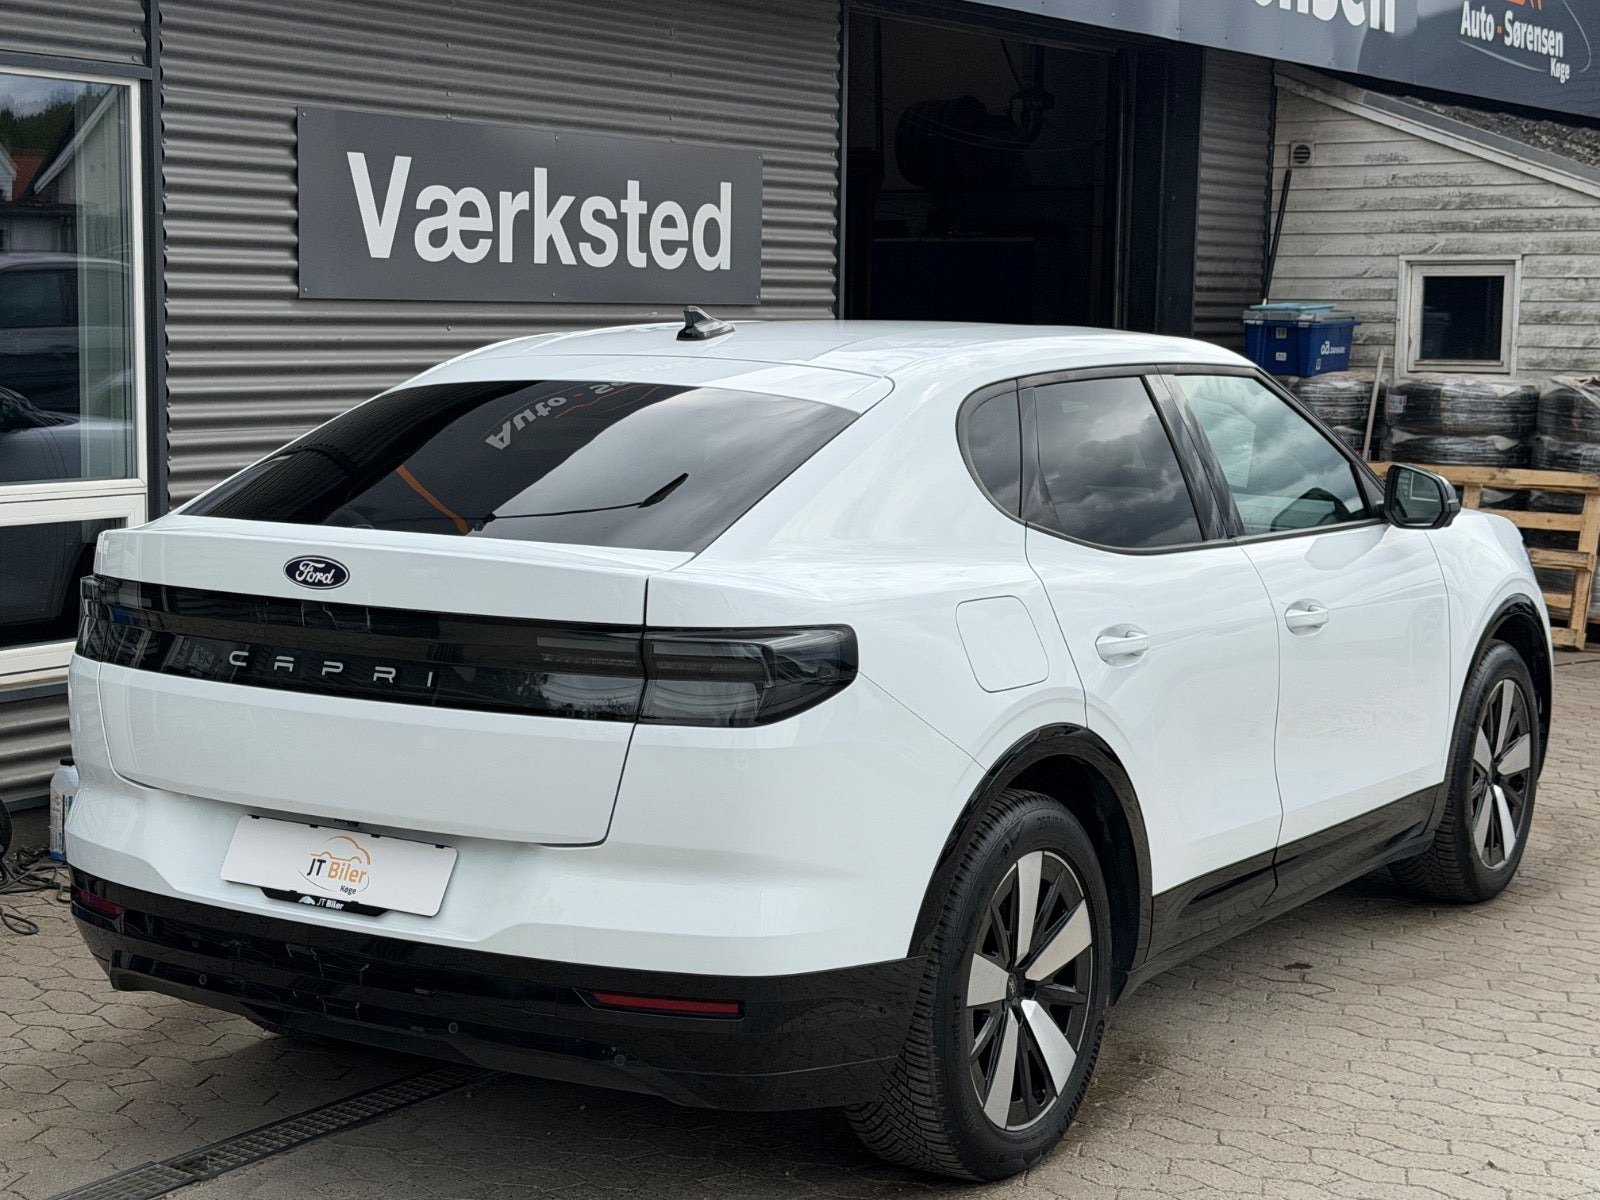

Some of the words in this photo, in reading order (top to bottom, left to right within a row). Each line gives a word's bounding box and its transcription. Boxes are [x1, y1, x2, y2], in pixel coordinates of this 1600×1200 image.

[1460, 1, 1495, 42] Auto
[1504, 10, 1564, 58] Sørensen
[1550, 58, 1571, 84] Køge
[346, 151, 732, 272] Værksted
[296, 560, 336, 585] Ford
[228, 650, 434, 688] CAPRI
[306, 858, 326, 876] JT
[327, 861, 367, 883] Biler
[340, 884, 357, 895] Køge
[317, 898, 326, 907] JT
[326, 899, 344, 910] Biler
